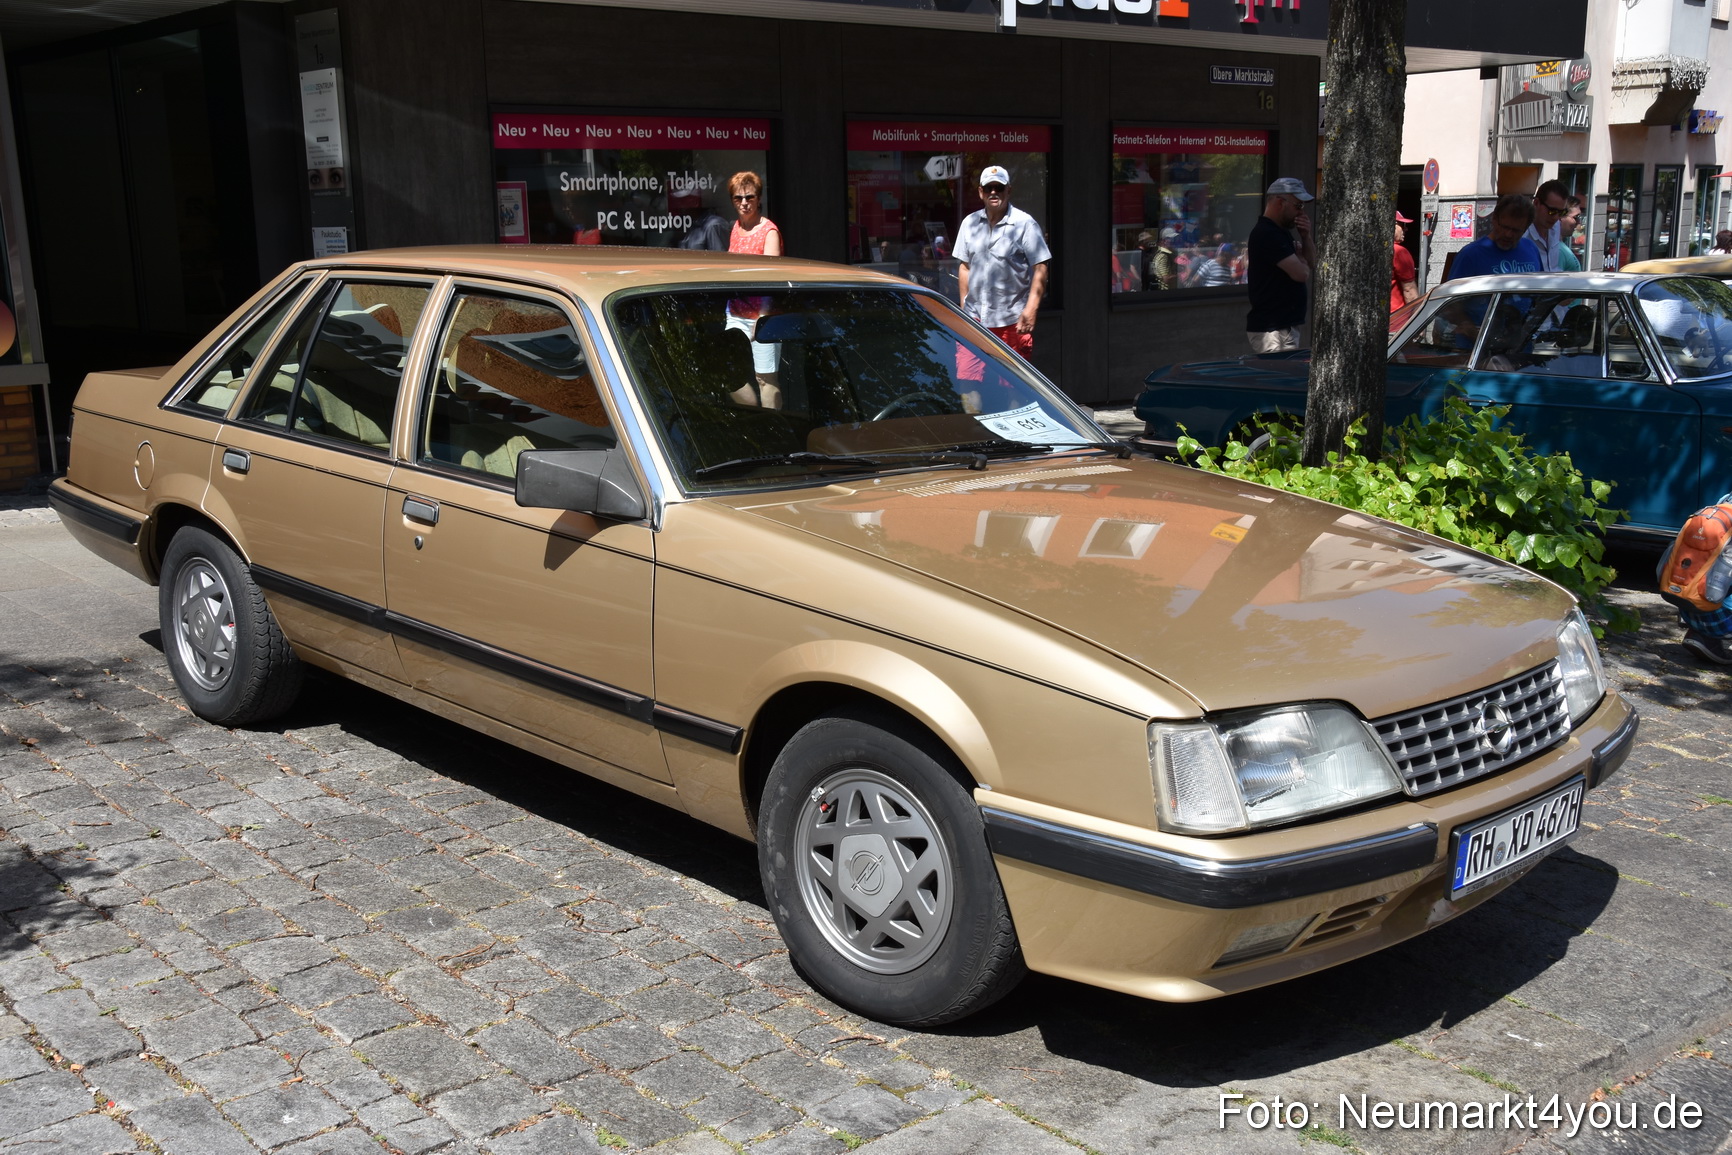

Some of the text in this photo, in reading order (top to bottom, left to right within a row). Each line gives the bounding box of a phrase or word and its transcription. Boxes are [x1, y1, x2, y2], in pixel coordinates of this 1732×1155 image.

[313, 43, 325, 65] 1a
[1212, 67, 1274, 84] Obere Marktstraße
[1258, 90, 1274, 110] 1a
[1566, 103, 1589, 128] PIZZA
[498, 123, 766, 140] Neu Neu Neu Neu Neu Neu Neu
[872, 129, 1029, 144] Mobilfunk Smartphones Tablets
[1113, 134, 1266, 147] Festnetz-Telefon Internet DSL-Installation
[559, 171, 717, 195] Smartphone, Tablet,
[597, 210, 692, 234] PC & Laptop
[1017, 417, 1047, 431] 615
[1465, 786, 1583, 879] RH XD 467H
[1455, 867, 1462, 879] D
